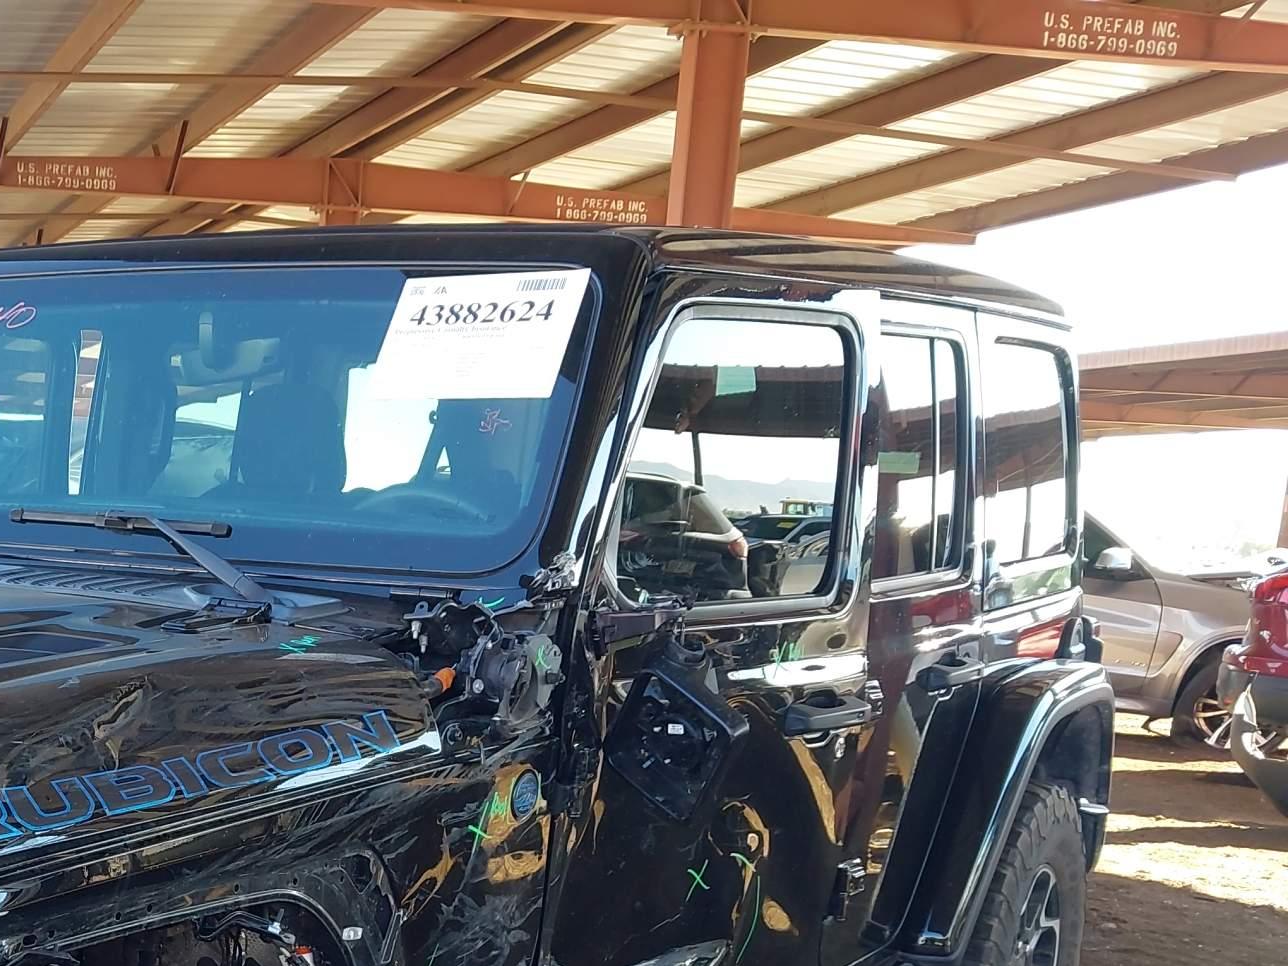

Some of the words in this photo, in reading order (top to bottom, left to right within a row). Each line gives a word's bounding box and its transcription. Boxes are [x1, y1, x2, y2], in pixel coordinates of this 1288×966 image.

[1044, 11, 1073, 30] U.S.
[1082, 15, 1144, 36] PREFAB
[1151, 20, 1181, 39] INC.
[1042, 31, 1178, 57] 1-866-799-0969
[17, 161, 39, 174] U.S.
[45, 163, 90, 177] PREFAB
[95, 166, 117, 179] INC.
[17, 174, 116, 191] 1-866-799-0969
[556, 195, 577, 208] U.S.
[582, 197, 624, 210] PREFAB
[628, 201, 649, 213] INC.
[556, 207, 647, 224] 1866-799-0969
[409, 299, 555, 326] 43882624
